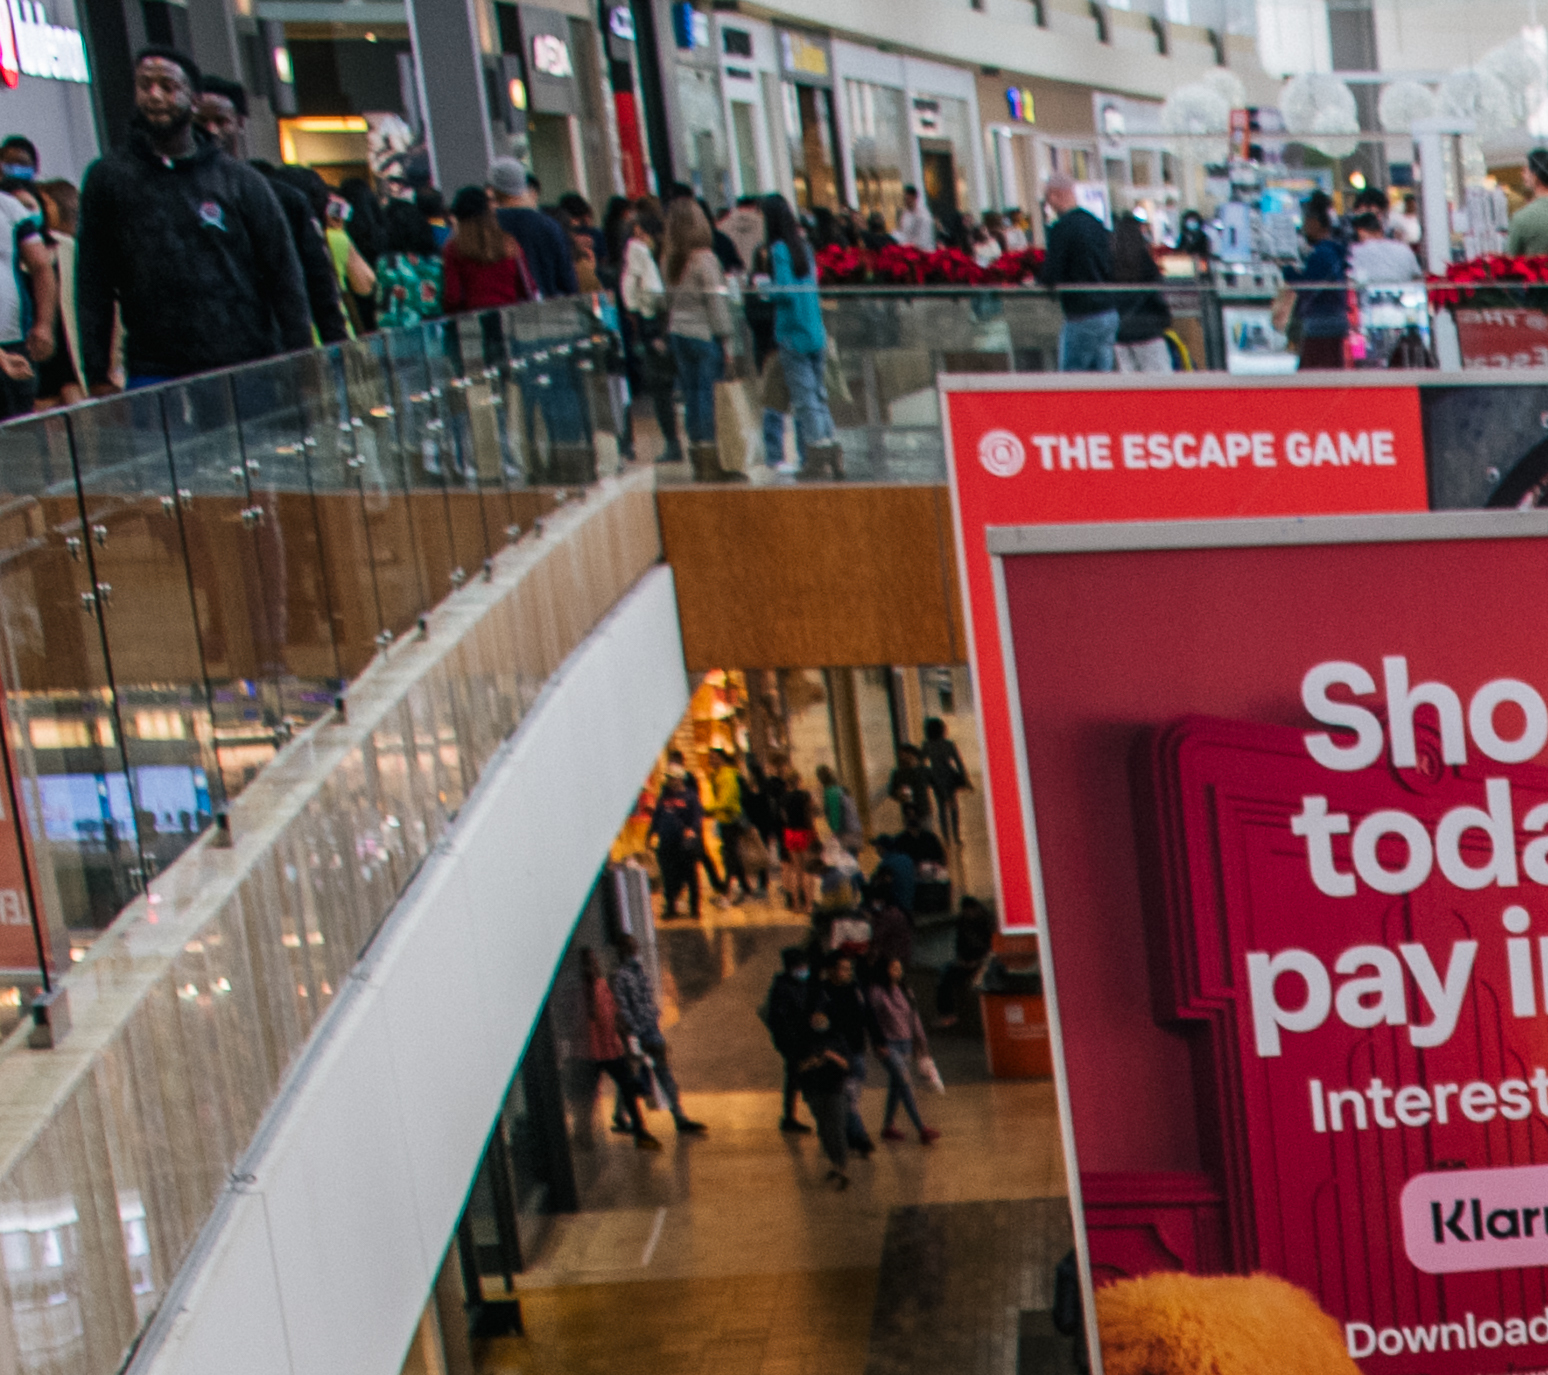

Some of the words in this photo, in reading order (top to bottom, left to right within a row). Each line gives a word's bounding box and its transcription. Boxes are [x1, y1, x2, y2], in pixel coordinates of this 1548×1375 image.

[1032, 433, 1113, 471] THE
[1123, 432, 1278, 471] ESCAPE
[1284, 430, 1397, 468] GAME
[1245, 930, 1479, 1058] pay
